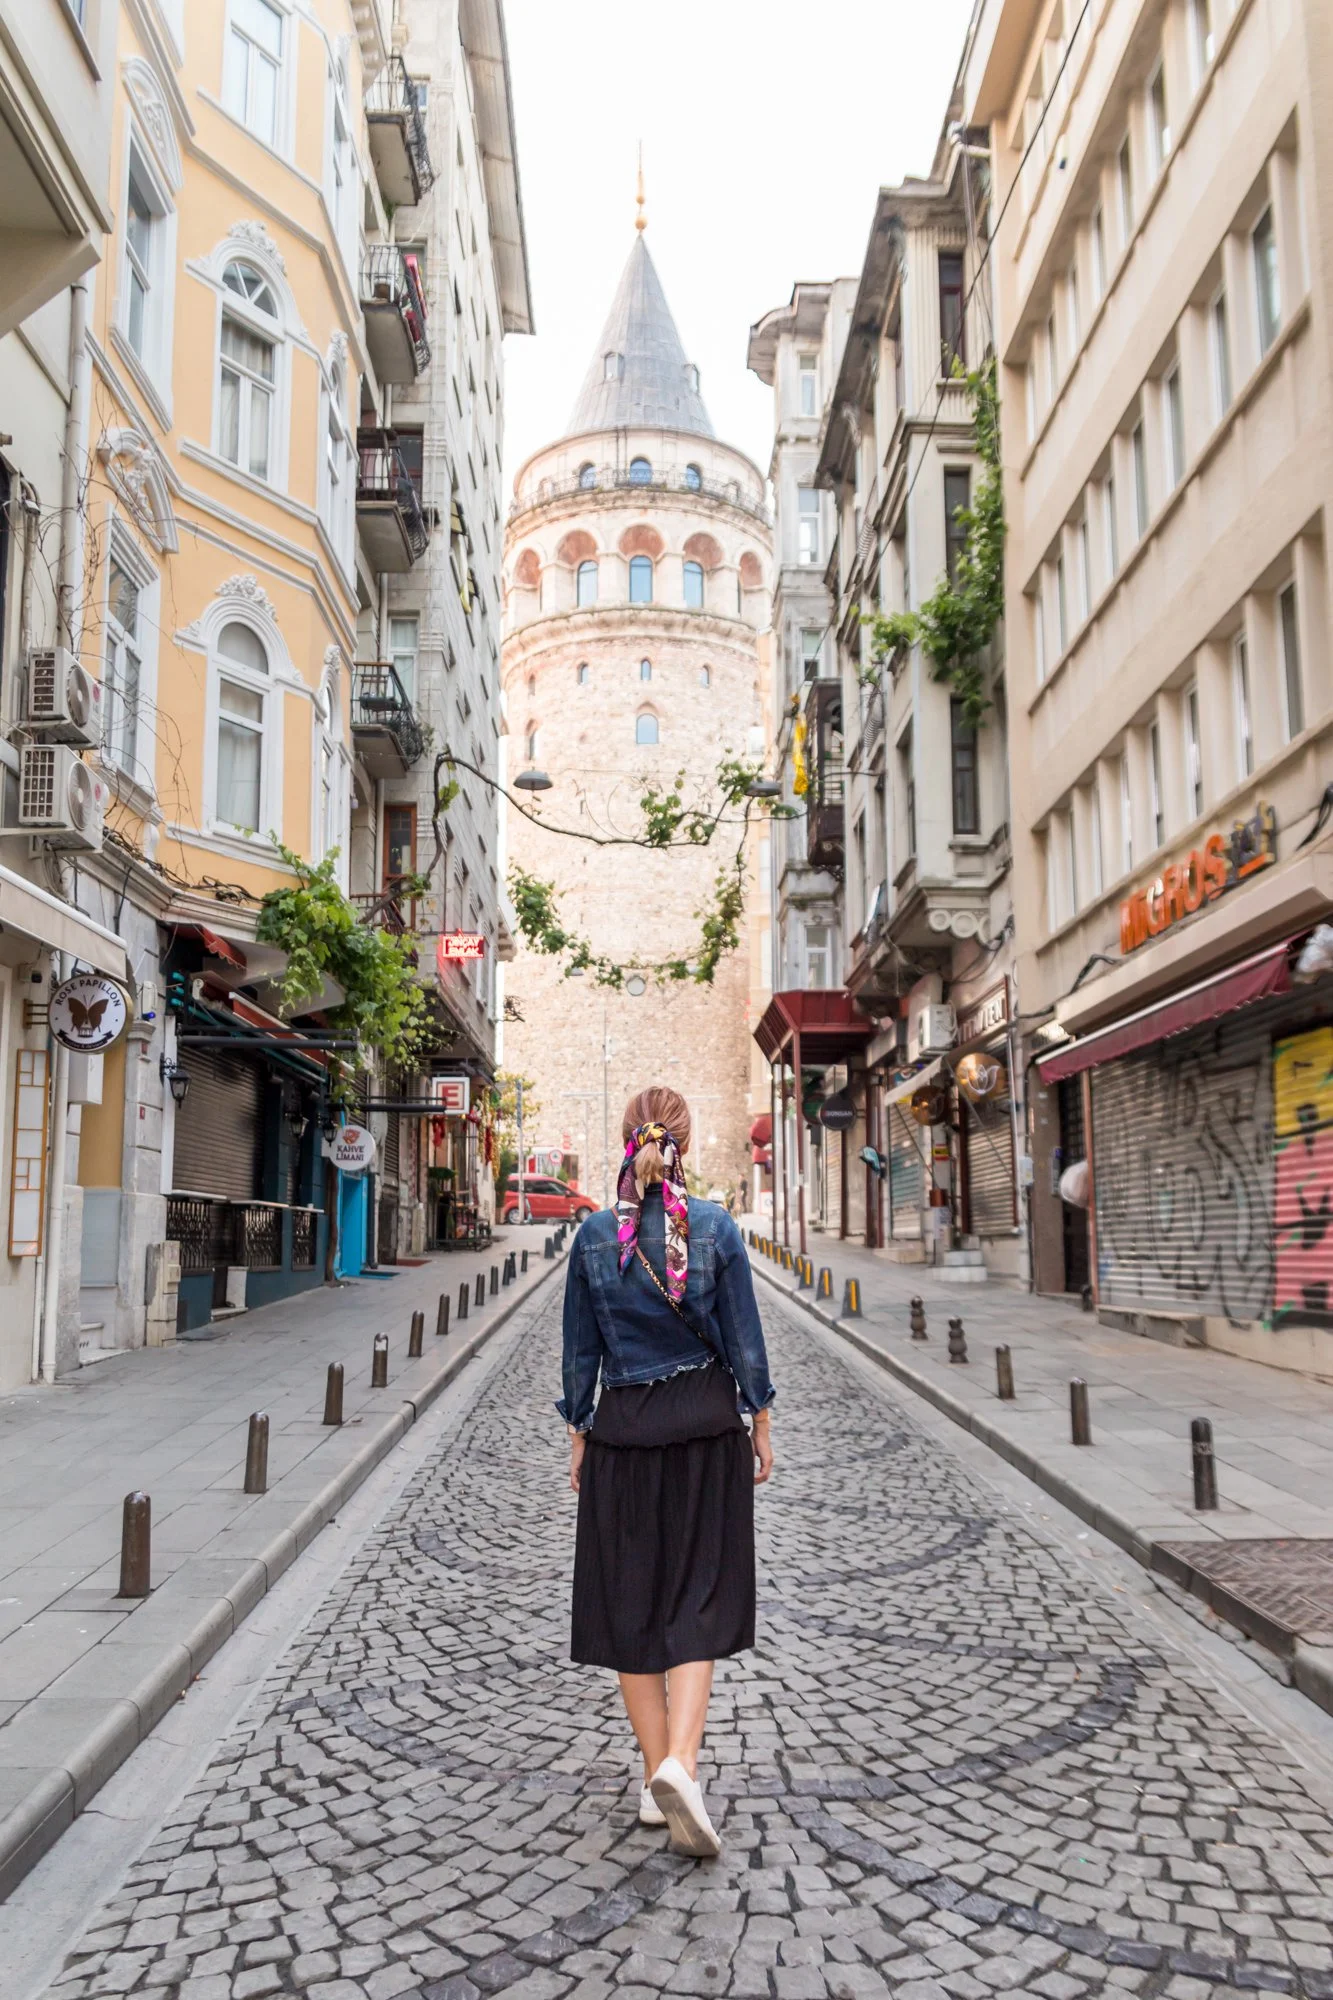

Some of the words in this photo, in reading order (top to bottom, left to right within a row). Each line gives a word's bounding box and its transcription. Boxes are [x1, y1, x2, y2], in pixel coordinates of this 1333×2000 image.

[449, 947, 479, 956] EMLAK
[55, 982, 77, 1006] ROSE
[79, 979, 121, 1007] PAPILLON
[442, 1085, 459, 1106] E
[337, 1145, 365, 1153] KAHVE
